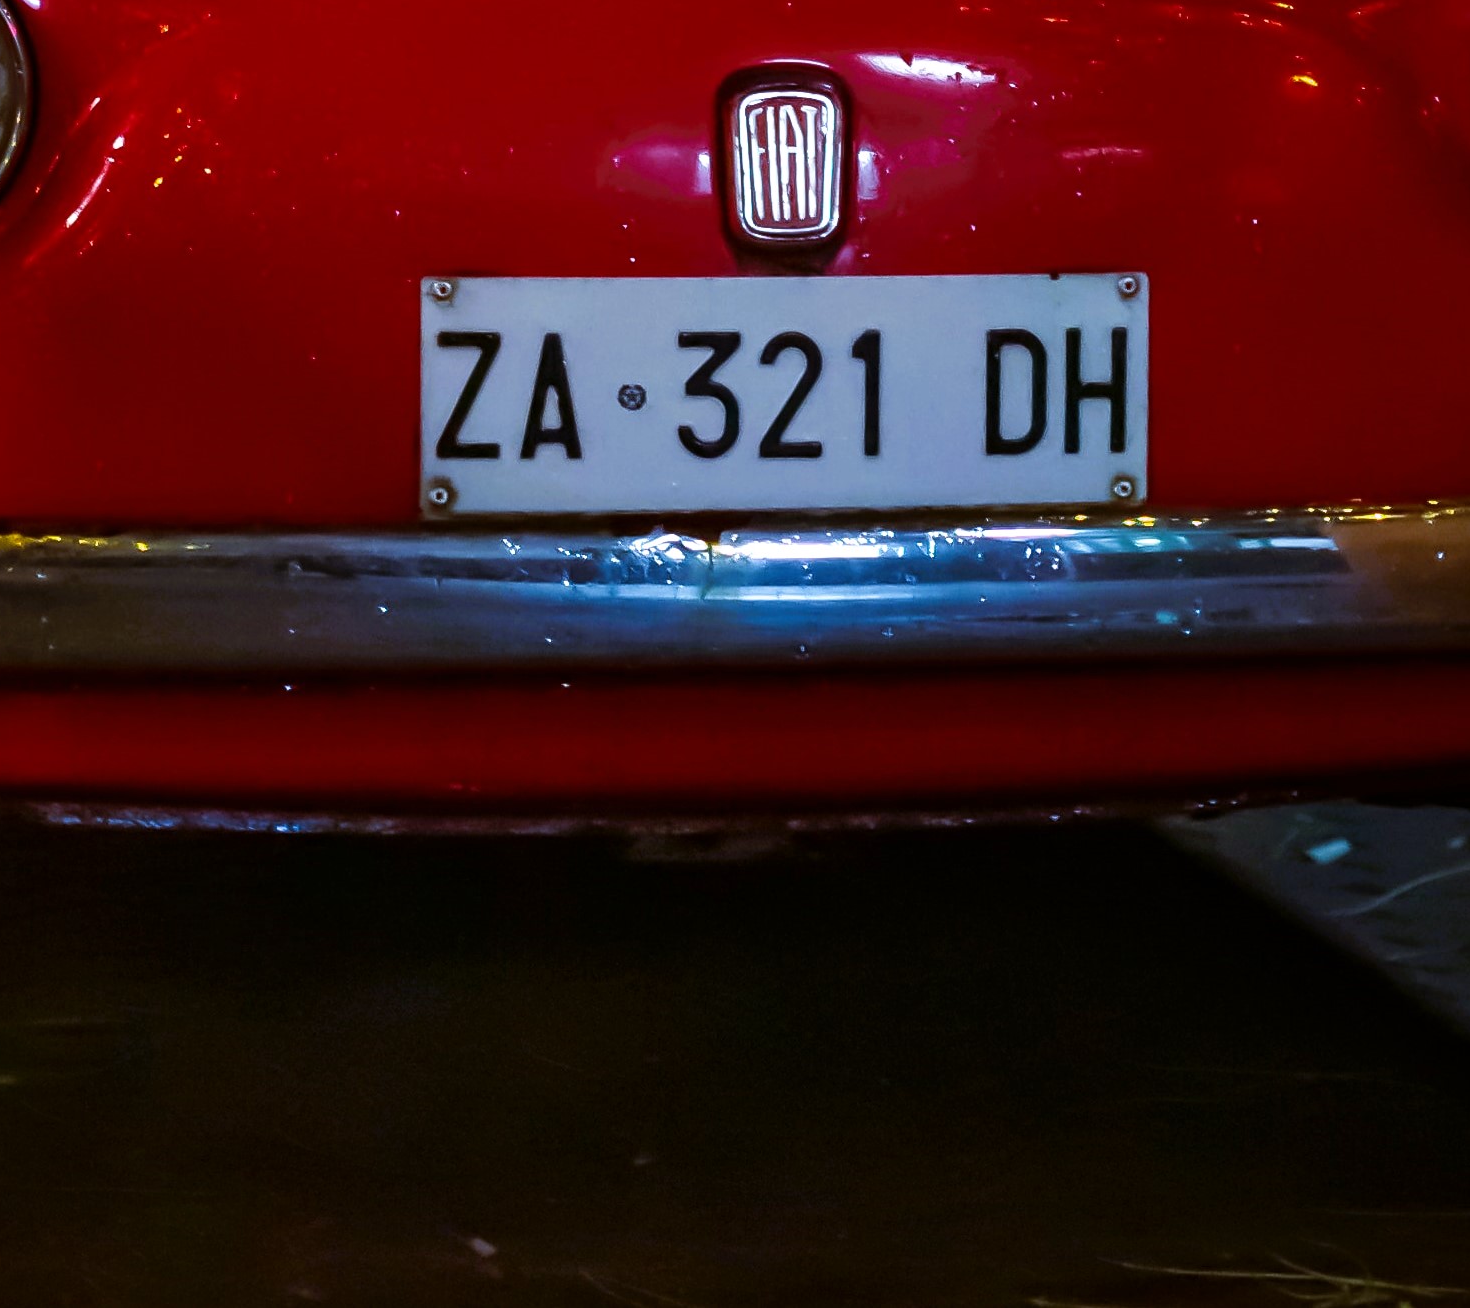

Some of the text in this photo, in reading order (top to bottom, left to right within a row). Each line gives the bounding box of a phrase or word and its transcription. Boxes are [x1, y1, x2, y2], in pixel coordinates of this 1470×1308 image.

[749, 103, 819, 222] FIAT
[436, 327, 1129, 460] ZA 321 DH
